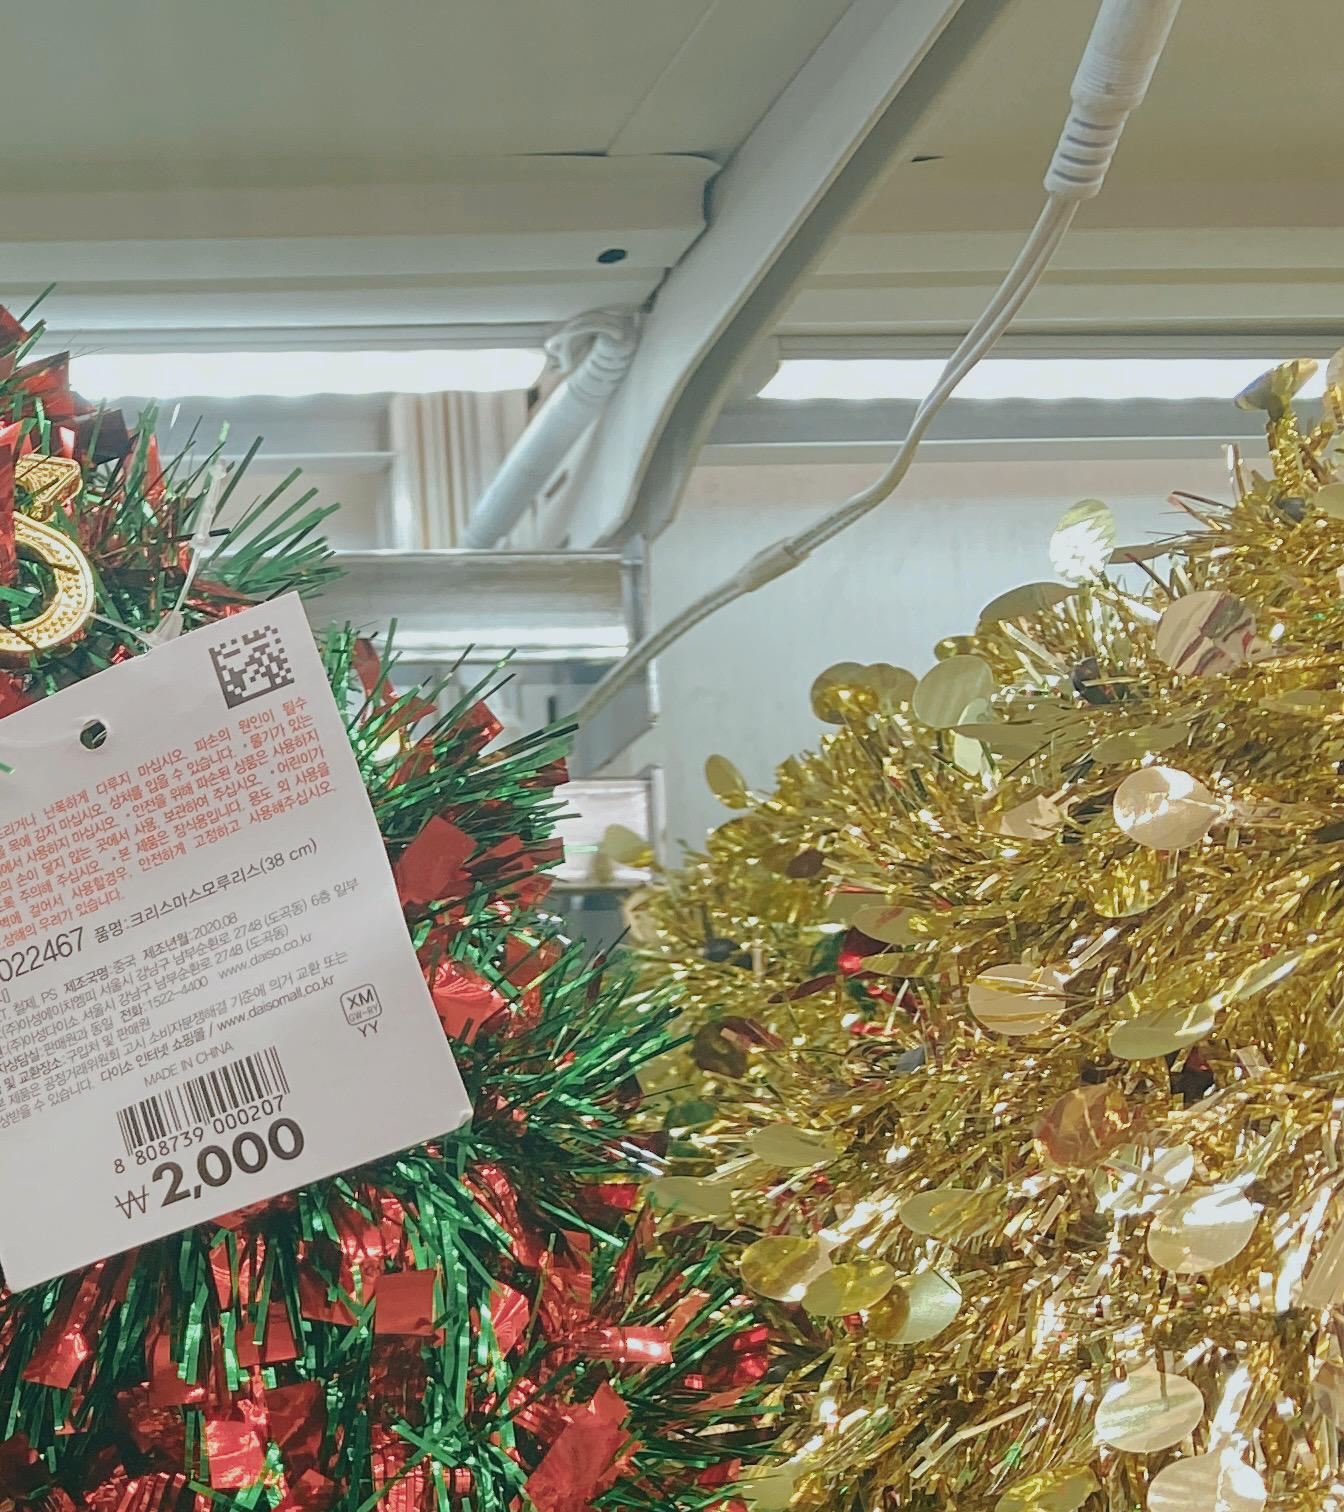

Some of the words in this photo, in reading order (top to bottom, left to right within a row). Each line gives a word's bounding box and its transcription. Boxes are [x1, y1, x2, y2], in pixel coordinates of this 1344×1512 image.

[8, 833, 31, 851] 목에
[33, 822, 57, 843] 감지
[109, 784, 142, 809] 상처를
[144, 773, 169, 794] 입을
[171, 767, 184, 781] 수
[249, 722, 285, 749] 물기가
[287, 714, 313, 733] 있는
[26, 835, 70, 863] 사용하지
[131, 793, 166, 818] 안전을
[169, 780, 194, 801] 위해
[195, 764, 230, 789] 파손된
[233, 749, 268, 774] 상품은
[272, 728, 319, 757] 사용하지
[43, 789, 89, 820] 난폭하게
[95, 770, 131, 794] 다루지
[194, 727, 231, 751] 파손의
[238, 708, 275, 734] 원인이
[15, 866, 39, 887] 손이
[68, 847, 92, 865] 않는
[95, 827, 130, 853] 곳에서
[163, 793, 209, 823] 보관하여
[276, 744, 324, 773] 어린이가
[18, 879, 53, 903] 주의해
[118, 845, 131, 862] 본
[134, 830, 169, 853] 제품은
[248, 786, 273, 806] 용도
[276, 777, 290, 793] 외
[295, 761, 329, 785] 사용을
[289, 837, 316, 860] cm)
[28, 892, 64, 918] 걸어서
[138, 841, 186, 871] 안전하게
[193, 819, 241, 848] 고정하고
[39, 907, 73, 931] 우려가
[99, 971, 133, 996] 서울시
[135, 957, 170, 981] 강남구
[172, 932, 231, 965] 남부순환로
[233, 918, 262, 939] 2748
[264, 898, 307, 927] (도곡동)
[310, 889, 331, 906] 6층
[333, 877, 358, 897] 일부
[40, 987, 57, 1003] PS
[82, 997, 116, 1021] 서울시
[117, 981, 152, 1006] 강남구
[154, 956, 212, 990] 남부순환로
[214, 943, 243, 964] 2748
[245, 923, 288, 951] (도곡동)
[90, 1015, 113, 1036] 동일
[217, 933, 311, 979] www.daiso.co.kr
[346, 988, 374, 1009] XM
[3, 1075, 16, 1091] 및
[101, 1031, 114, 1048] 및
[115, 1016, 150, 1041] 판매원
[7, 1082, 41, 1105] 제품은
[122, 1035, 146, 1056] 고시
[230, 983, 266, 1007] 기준에
[268, 971, 293, 991] 의거
[295, 960, 320, 980] 교환
[323, 951, 347, 968] 또는
[33, 1098, 45, 1112] 수
[100, 1060, 133, 1081] 다이소
[135, 1042, 168, 1067] 인터넷
[172, 1026, 204, 1051] 쇼핑몰
[216, 975, 333, 1030] www.daisomall.co.kr
[143, 1063, 178, 1087] MADE
[180, 1056, 193, 1071] IN
[195, 1040, 234, 1064] CHINA
[356, 1019, 377, 1037] YY
[131, 1126, 203, 1165] 808739
[212, 1094, 282, 1134] 000207
